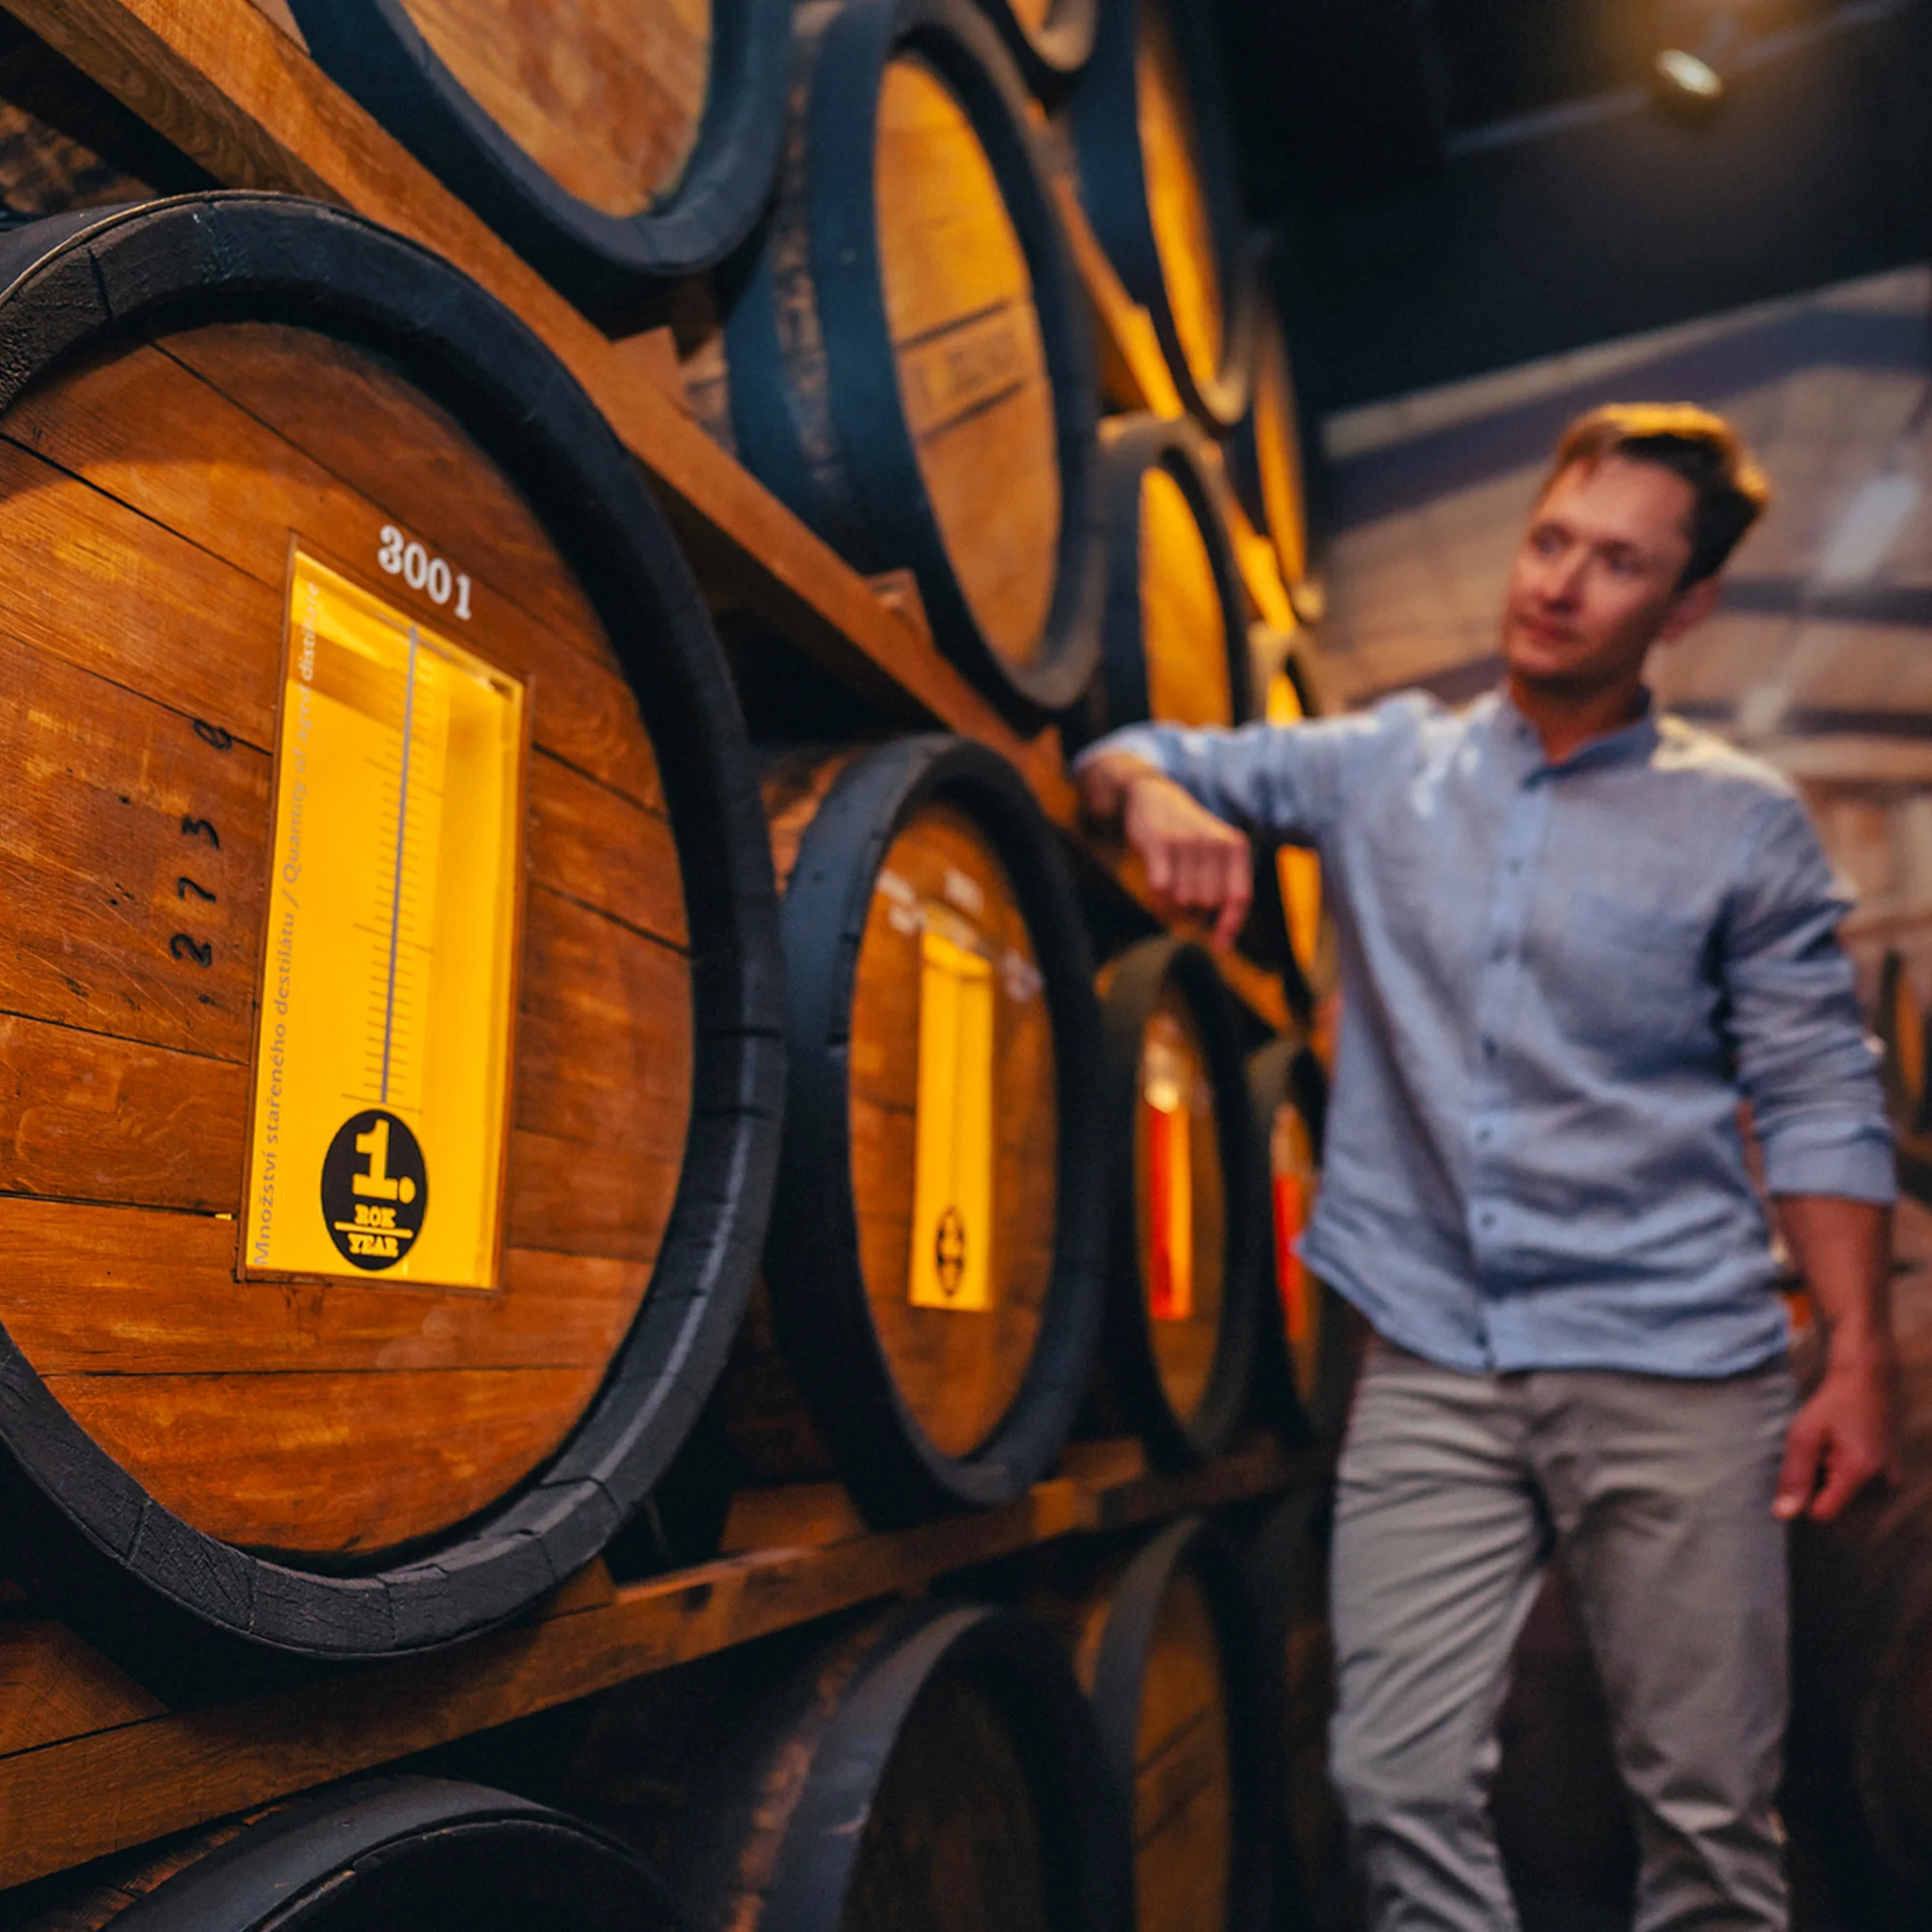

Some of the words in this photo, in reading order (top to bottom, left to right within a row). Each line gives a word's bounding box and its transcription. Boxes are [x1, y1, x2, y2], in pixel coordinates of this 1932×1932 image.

[378, 525, 471, 620] 3001
[293, 747, 306, 773] of
[298, 684, 313, 743] aged
[282, 780, 307, 883] Quantity
[273, 913, 295, 1014] destilátu
[267, 1024, 287, 1144] stařeného
[254, 1151, 277, 1264] Množství
[348, 1233, 399, 1258] YEAR
[354, 1204, 397, 1229] ROK
